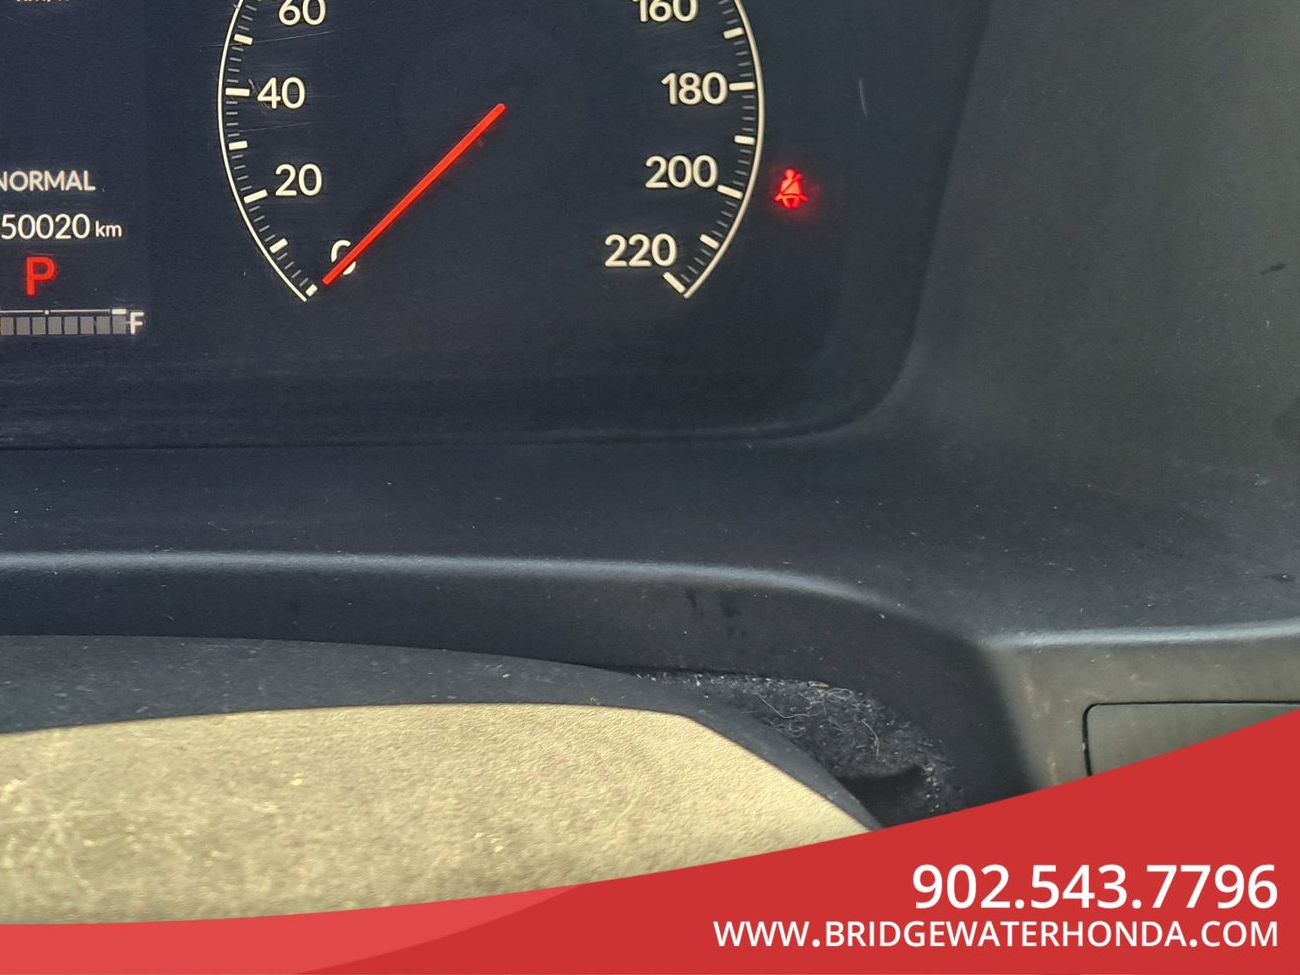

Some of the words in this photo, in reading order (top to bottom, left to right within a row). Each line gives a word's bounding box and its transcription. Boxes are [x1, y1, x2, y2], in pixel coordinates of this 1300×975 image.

[258, 77, 305, 108] 40
[662, 72, 727, 104] 180
[276, 164, 321, 195] 20
[645, 154, 718, 188] 200
[96, 221, 122, 237] km
[605, 234, 676, 266] 220
[26, 257, 56, 295] P
[129, 312, 144, 334] F
